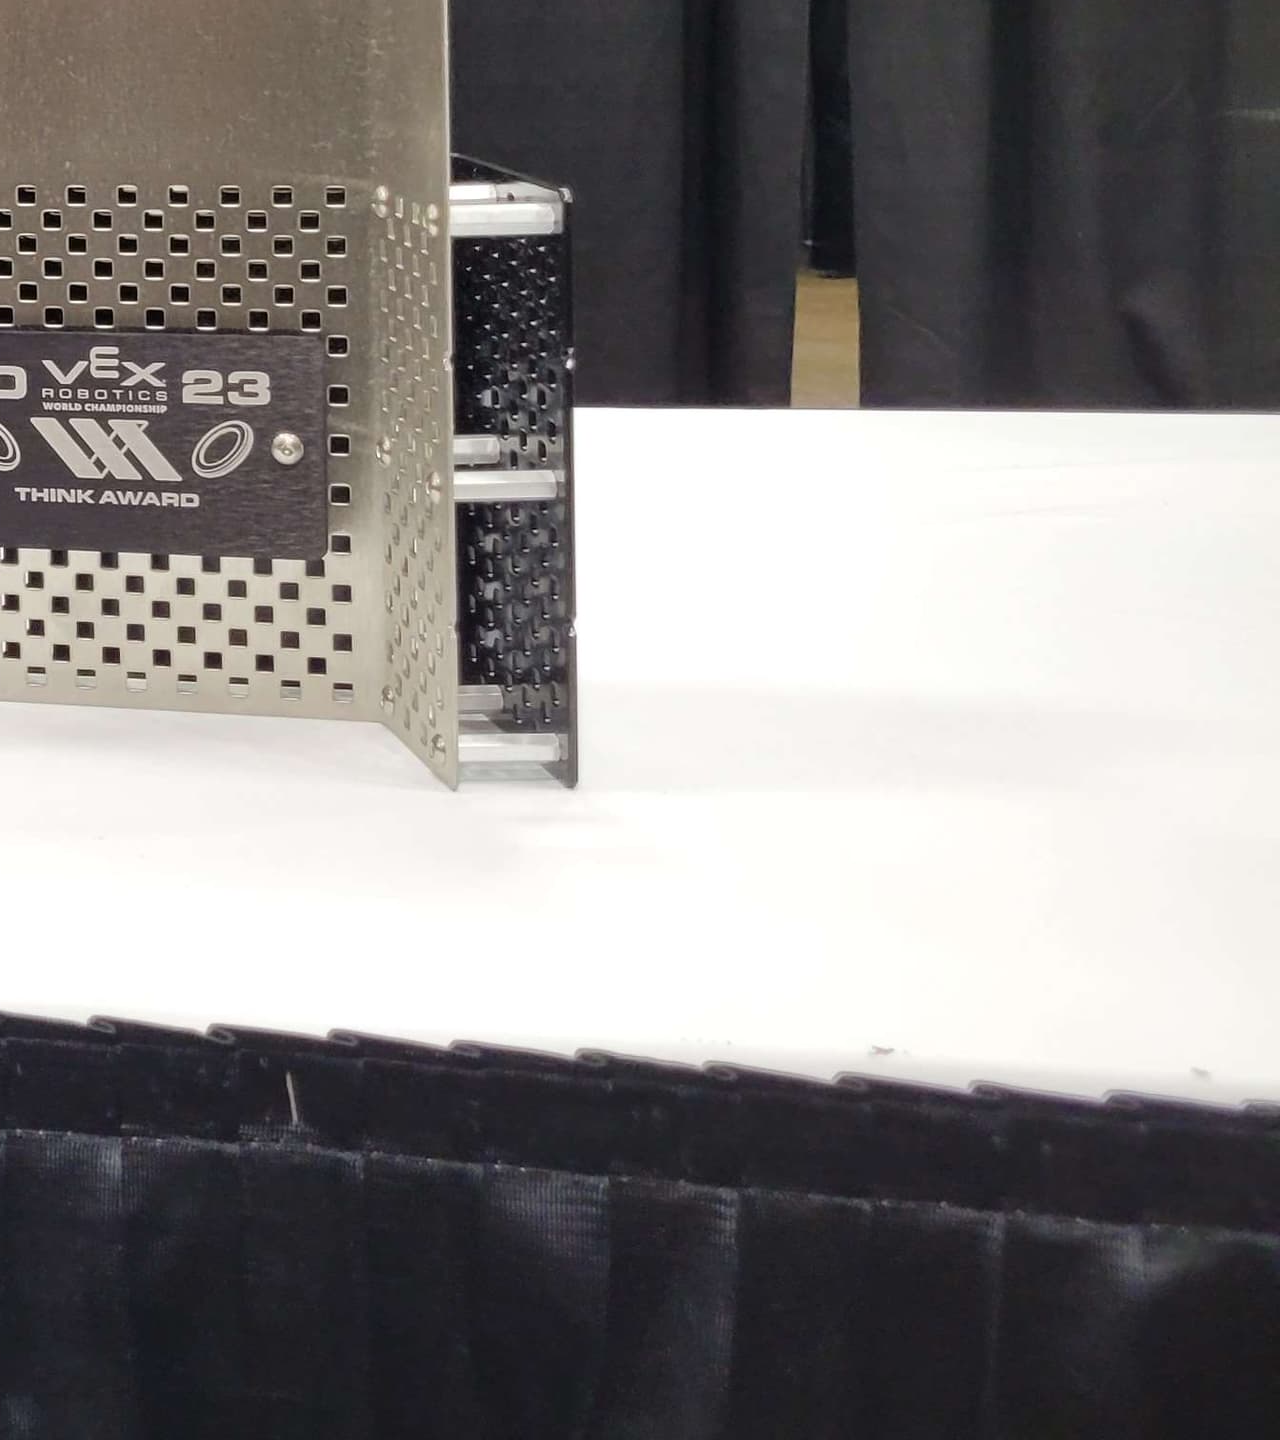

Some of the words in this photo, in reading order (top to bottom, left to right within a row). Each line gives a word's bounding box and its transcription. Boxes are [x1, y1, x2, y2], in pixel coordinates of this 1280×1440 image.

[41, 346, 167, 387] VEX
[41, 388, 168, 402] ROBOTICS
[181, 369, 272, 406] 23
[42, 401, 82, 412] WORLD
[84, 403, 168, 414] CHAMPIONSHIP
[14, 486, 95, 505] THINK
[99, 489, 200, 508] AWARD
